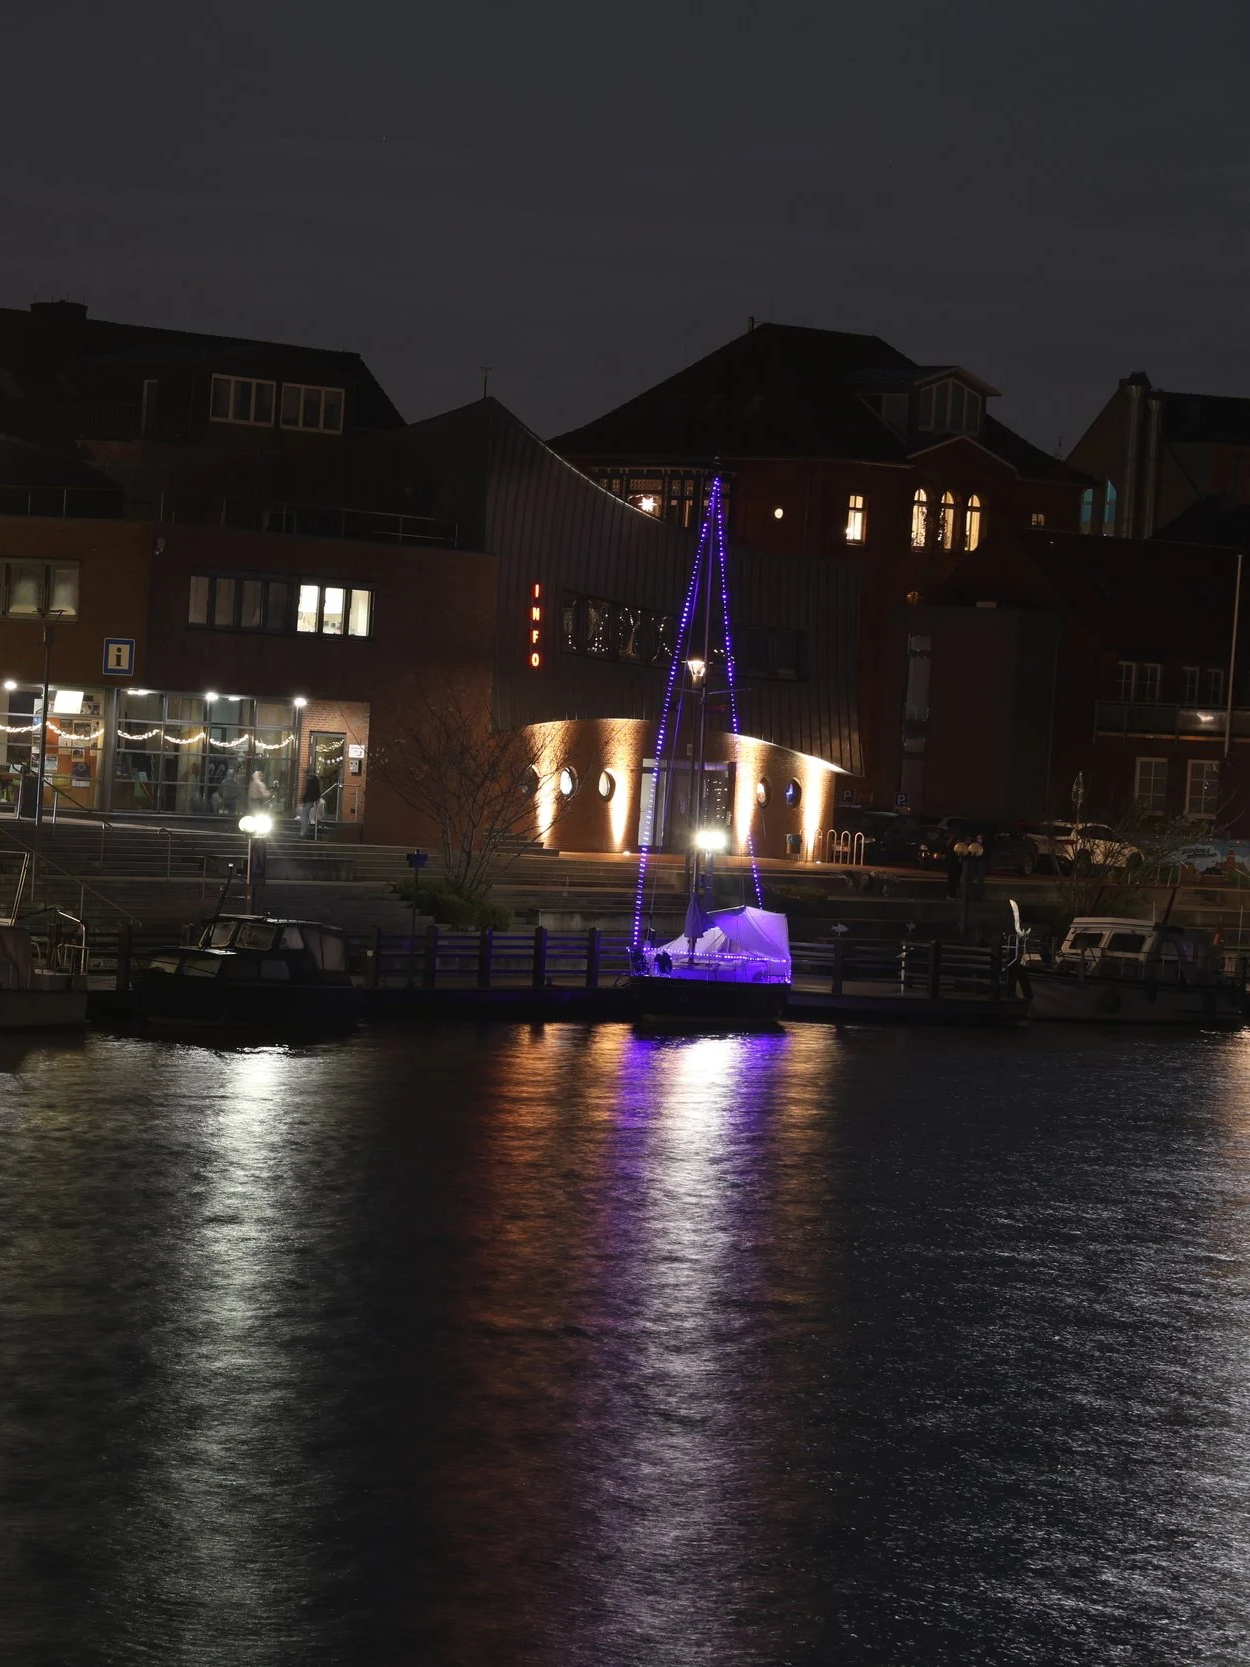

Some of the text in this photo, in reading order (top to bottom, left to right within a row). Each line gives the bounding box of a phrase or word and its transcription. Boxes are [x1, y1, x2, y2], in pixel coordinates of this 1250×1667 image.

[531, 583, 541, 667] INFO
[114, 647, 123, 667] i
[897, 794, 906, 806] P
